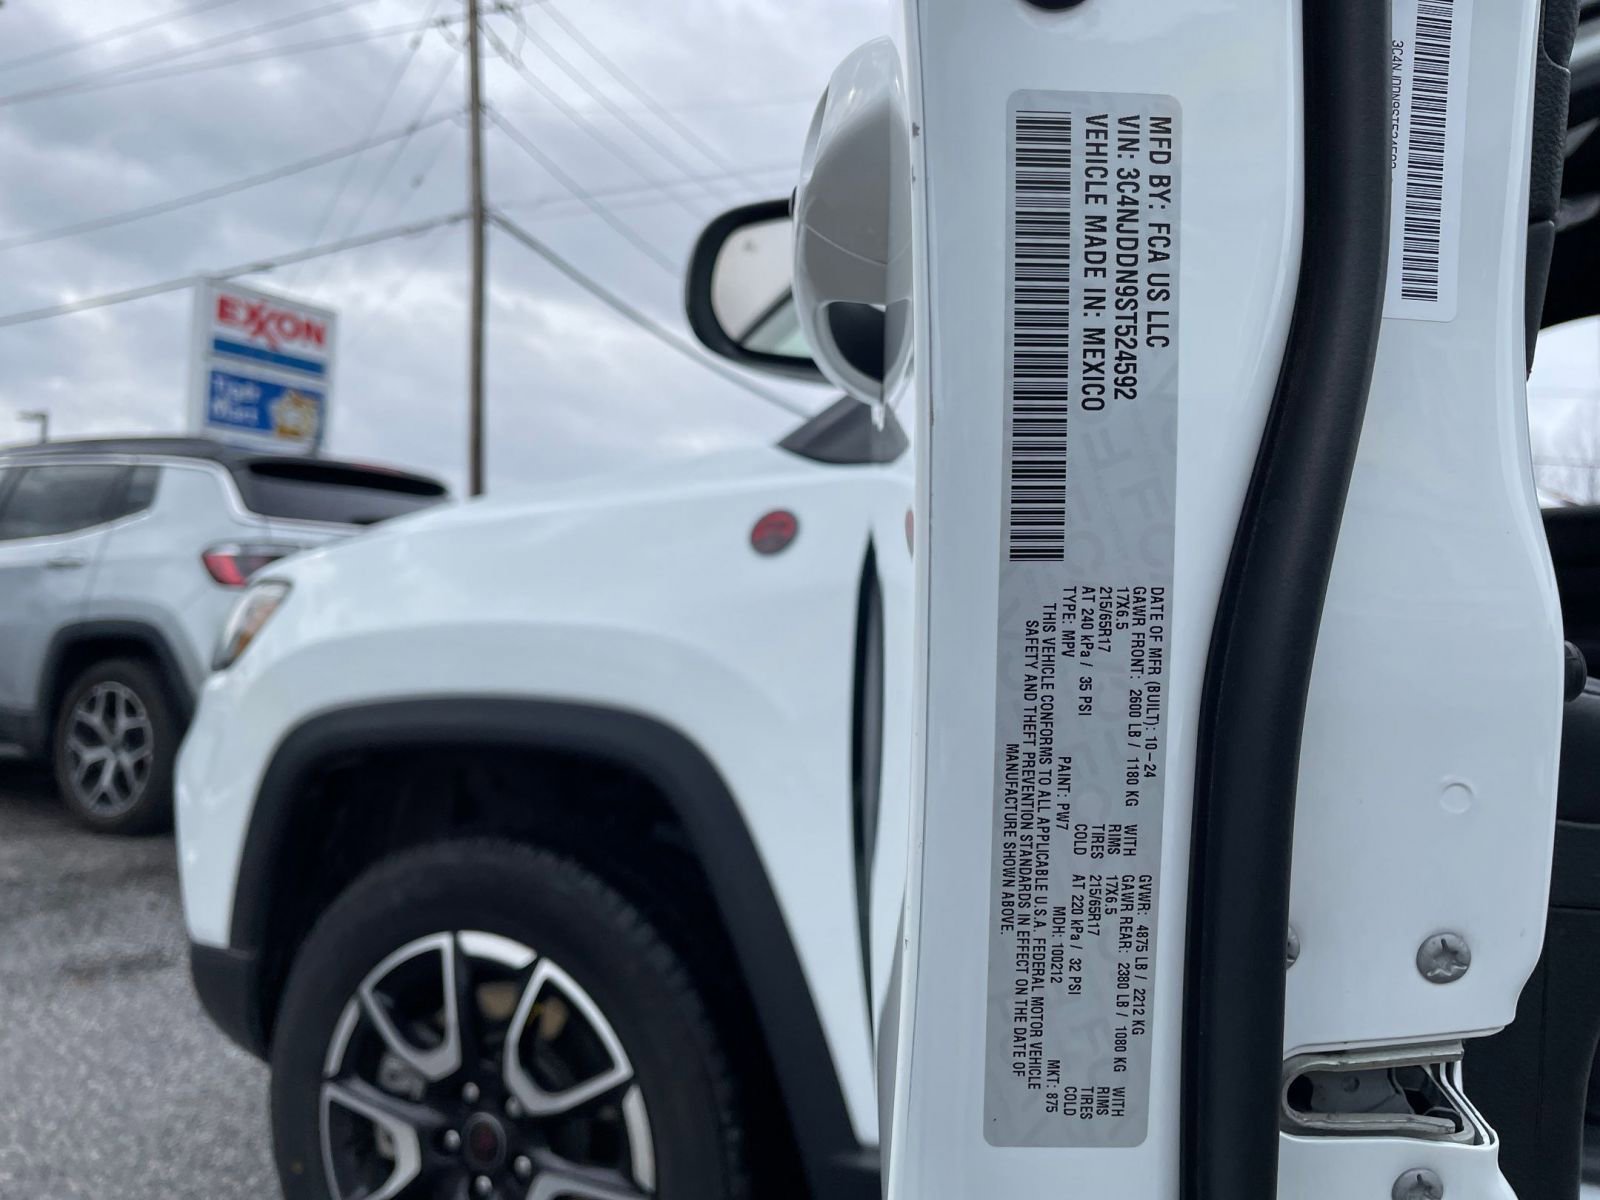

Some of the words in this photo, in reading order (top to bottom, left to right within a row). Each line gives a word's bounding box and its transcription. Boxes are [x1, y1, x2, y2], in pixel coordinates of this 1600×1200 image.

[1117, 115, 1140, 159] VIN:
[1149, 117, 1172, 166] MFD
[1085, 114, 1108, 205] VEHICLE
[1149, 175, 1171, 209] BY:
[1084, 215, 1107, 278] MADE
[1148, 223, 1171, 263] FCA
[1113, 168, 1140, 400] 3C4NJDDN9ST524592
[1146, 273, 1170, 301] US
[1083, 288, 1106, 317] IN:
[216, 295, 326, 348] EXXON
[1146, 311, 1170, 348] LLC
[1081, 328, 1106, 411] MEXICO
[1062, 586, 1077, 624] TYPE:
[1082, 586, 1096, 603] AT
[1115, 586, 1130, 630] 17X6.5
[1132, 587, 1147, 627] GAWR
[1150, 587, 1164, 620] DATE
[1042, 603, 1057, 632] THIS
[1081, 608, 1094, 630] 240
[1097, 587, 1113, 652] 215/65R17
[1025, 620, 1039, 670] SAFETY
[1061, 630, 1076, 658] MPV
[1080, 635, 1094, 657] kPa
[1149, 626, 1163, 642] OF
[1041, 637, 1056, 690] VEHICLE
[1130, 632, 1145, 679] FRONT:
[1147, 648, 1162, 675] MFR
[1024, 674, 1038, 701] AND
[1079, 676, 1092, 691] 35
[1078, 696, 1092, 715] PSI
[1129, 689, 1142, 717] 2600
[1145, 681, 1160, 733] (BUILT):
[1023, 705, 1037, 746] THEFT
[1039, 695, 1054, 765] CONFORMS
[1128, 724, 1142, 737] LB
[1038, 769, 1052, 785] TO
[1057, 757, 1072, 797] PAINT:
[1126, 757, 1140, 785] 1180
[1003, 744, 1019, 837] MANUFACTURE
[1020, 752, 1036, 830] PREVENTION
[1037, 790, 1051, 813] ALL
[1125, 791, 1139, 806] KG
[1056, 803, 1070, 830] PW7
[1034, 815, 1050, 890] APPLICABLE
[1074, 824, 1088, 855] COLD
[1091, 824, 1105, 859] TIRES
[1107, 824, 1122, 855] RIMS
[1123, 824, 1137, 856] WITH
[1002, 842, 1016, 887] SHOWN
[1019, 834, 1033, 908] STANDARDS
[1072, 874, 1086, 890] AT
[1103, 875, 1119, 915] 17X6.5
[1120, 875, 1135, 912] GAWR
[1137, 875, 1152, 915] GVWR:
[1001, 892, 1015, 934] ABOVE.
[1017, 914, 1031, 925] IN
[1033, 897, 1047, 932] U.S.A.
[1071, 895, 1084, 915] 220
[1088, 875, 1102, 936] 215/65R17
[1052, 907, 1066, 937] MDH:
[1070, 920, 1084, 940] kPa
[1119, 917, 1133, 953] REAR:
[1016, 931, 1030, 974] EFFECT
[1136, 925, 1150, 952] 4875
[1029, 936, 1046, 992] FEDERAL
[1050, 943, 1064, 983] 100212
[1069, 958, 1082, 972] 32
[1117, 963, 1130, 989] 2380
[1135, 957, 1148, 970] LB
[1015, 979, 1028, 995] ON
[1068, 977, 1082, 994] PSI
[1116, 994, 1130, 1007] LB
[1014, 999, 1028, 1022] THE
[1133, 988, 1146, 1015] 2212
[1030, 997, 1044, 1038] MOTOR
[1132, 1020, 1145, 1035] KG
[1013, 1028, 1027, 1057] DATE
[1114, 1026, 1127, 1052] 1080
[1013, 1062, 1025, 1076] OF
[1028, 1042, 1042, 1089] VEHICLE
[1046, 1060, 1060, 1088] MKT:
[1113, 1057, 1127, 1072] KG
[1046, 1093, 1058, 1112] 875
[1063, 1087, 1077, 1116] COLD
[1080, 1086, 1094, 1120] TIRES
[1096, 1087, 1110, 1115] RIMS
[1111, 1087, 1125, 1116] WITH
